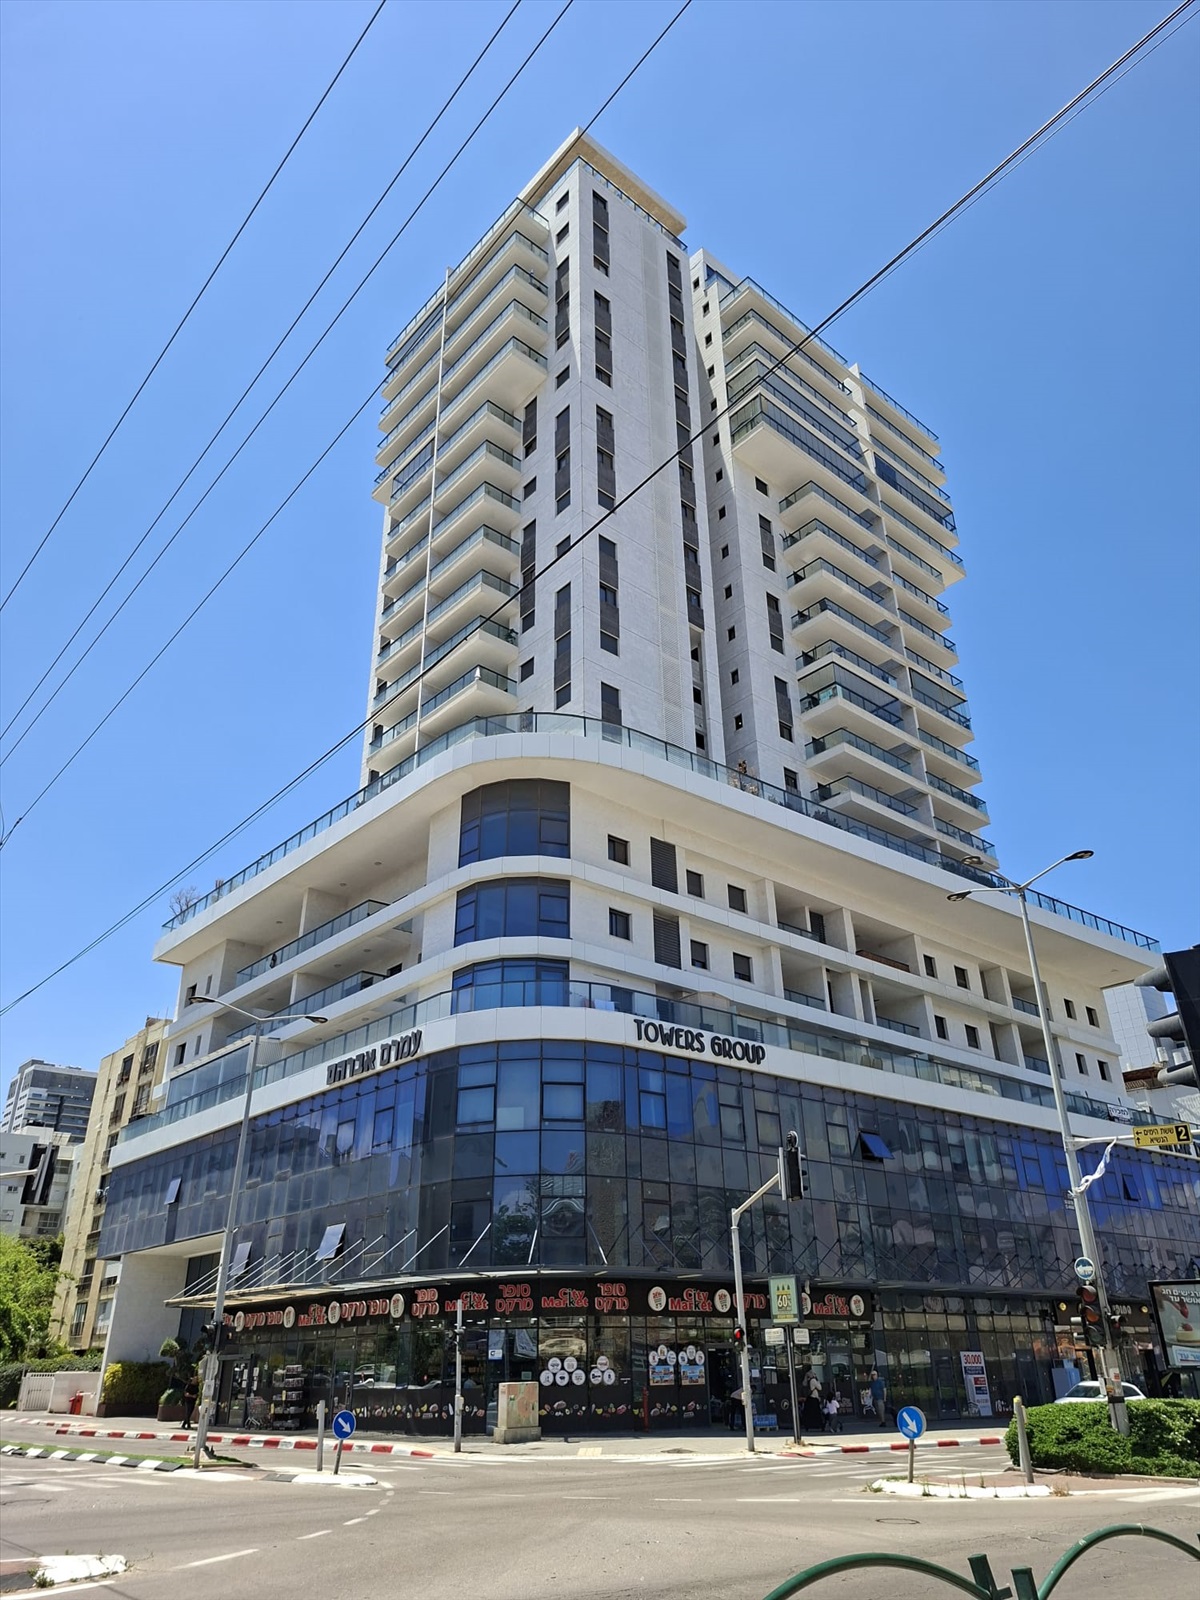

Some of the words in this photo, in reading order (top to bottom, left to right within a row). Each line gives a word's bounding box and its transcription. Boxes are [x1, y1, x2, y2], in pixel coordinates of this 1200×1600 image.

[380, 1029, 422, 1066] עמרם
[633, 1018, 706, 1053] TOWERS
[710, 1036, 767, 1066] GROUP
[326, 1049, 376, 1085] אברהם
[1178, 1126, 1187, 1140] 2
[414, 1288, 438, 1302] סופר
[498, 1284, 531, 1298] סופר
[558, 1288, 585, 1300] City
[597, 1283, 627, 1296] סופר
[683, 1288, 709, 1301] City
[461, 1291, 486, 1303] City
[541, 1296, 589, 1308] Market
[825, 1294, 847, 1307] City
[341, 1300, 367, 1321] מרקט
[367, 1299, 390, 1315] סופר
[411, 1302, 440, 1319] מרקט
[495, 1297, 534, 1315] מרקט
[595, 1297, 629, 1313] מרקט
[668, 1297, 713, 1312] Market
[813, 1302, 850, 1316] Market
[298, 1313, 328, 1326] Market
